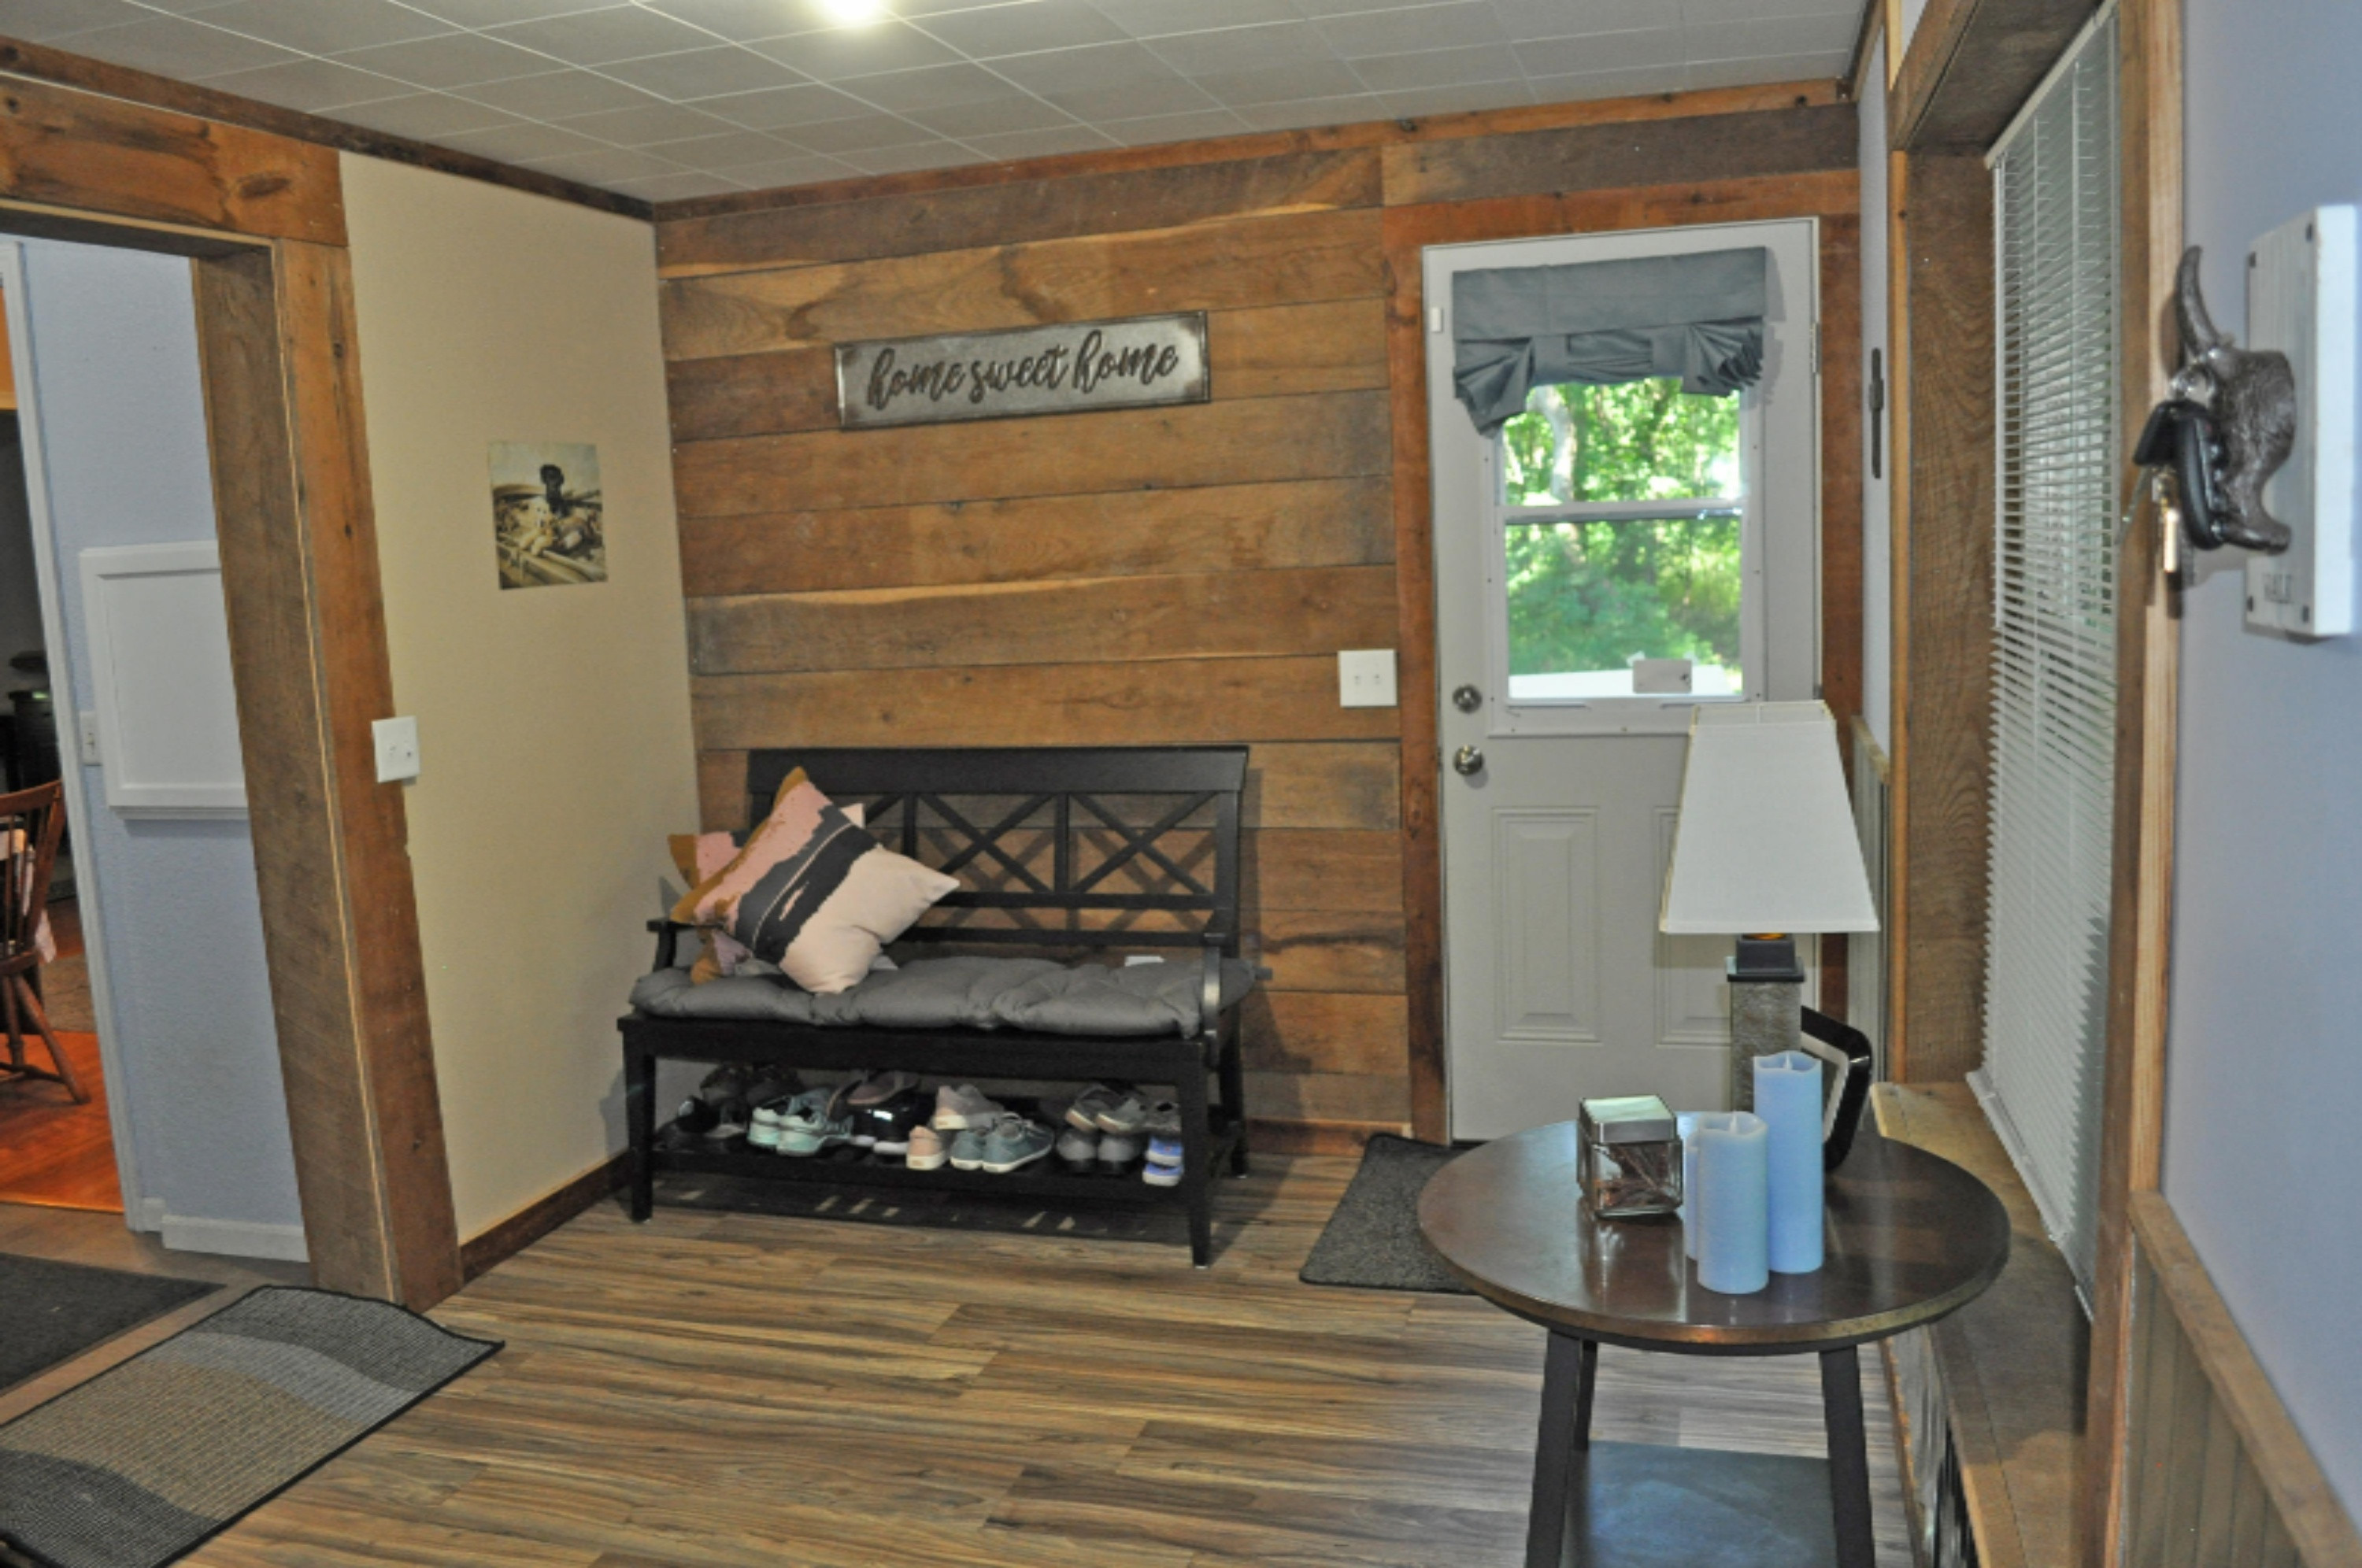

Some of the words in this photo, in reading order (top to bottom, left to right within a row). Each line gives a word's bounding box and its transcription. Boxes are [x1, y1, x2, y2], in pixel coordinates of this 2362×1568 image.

[866, 347, 967, 411] home
[968, 344, 1069, 404] sweet
[1072, 329, 1179, 394] home
